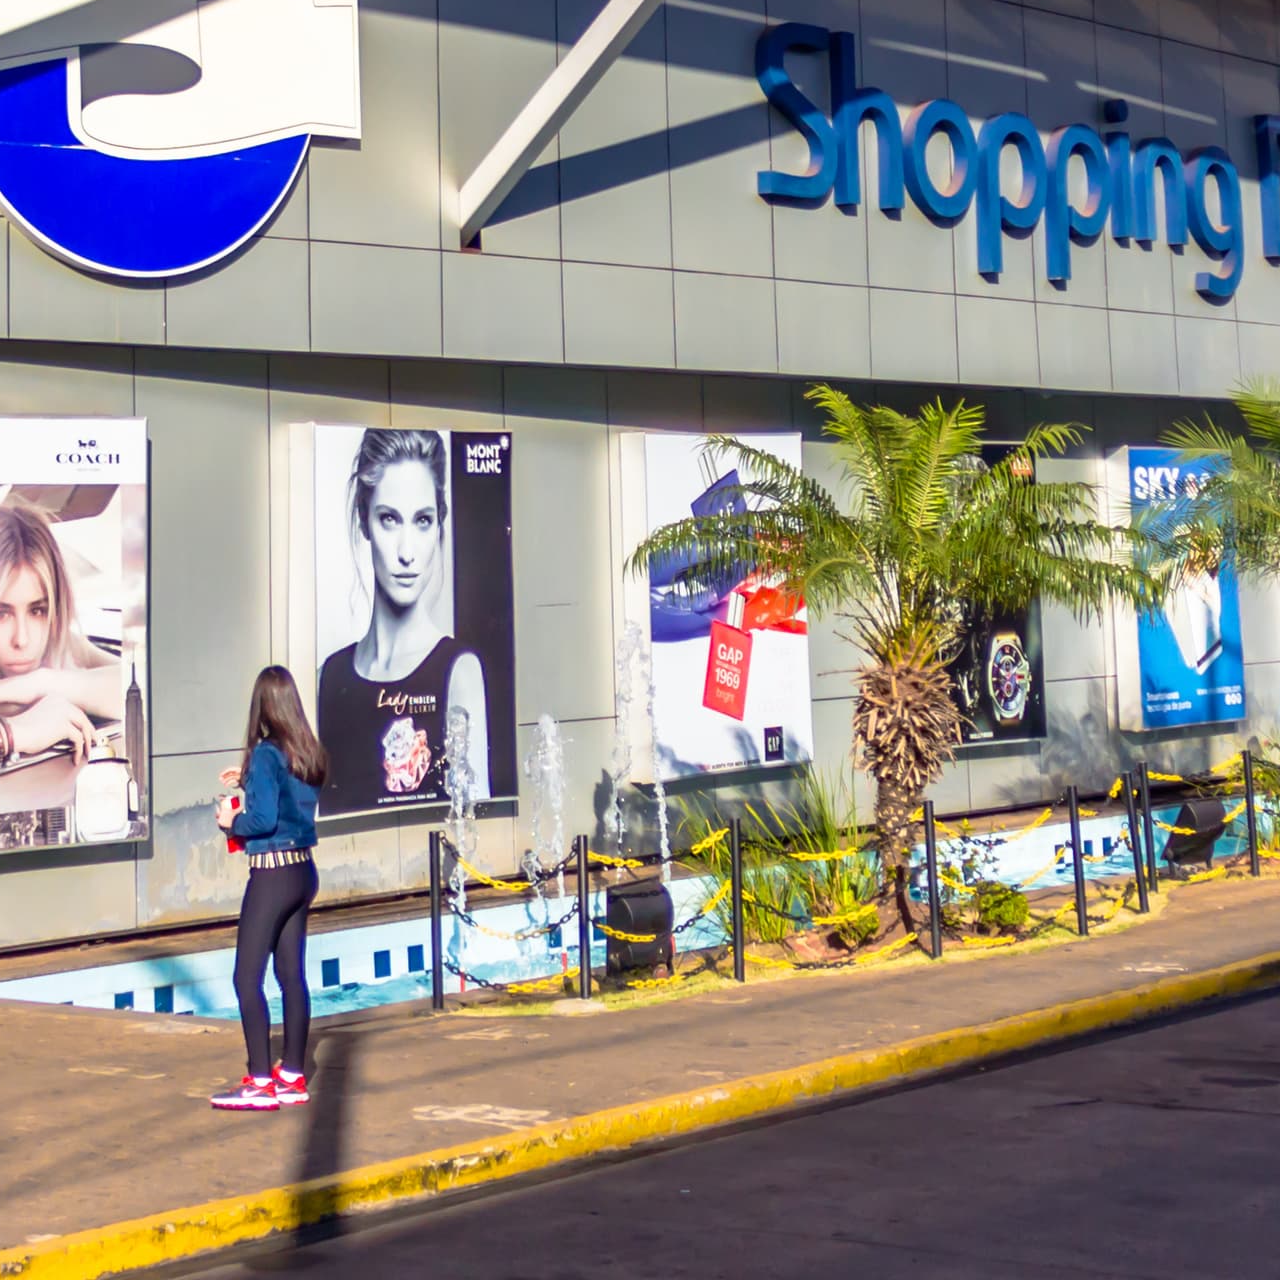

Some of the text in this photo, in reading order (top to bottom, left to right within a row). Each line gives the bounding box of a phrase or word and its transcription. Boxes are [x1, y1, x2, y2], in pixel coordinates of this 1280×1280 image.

[755, 22, 1243, 298] Shopping
[56, 453, 120, 464] COACH
[467, 444, 500, 458] MONT
[467, 459, 502, 473] BLANC
[1134, 466, 1179, 499] SKY
[718, 643, 743, 665] GAP
[715, 667, 740, 690] 1969
[377, 688, 409, 715] Lady
[767, 736, 780, 752] GAP
